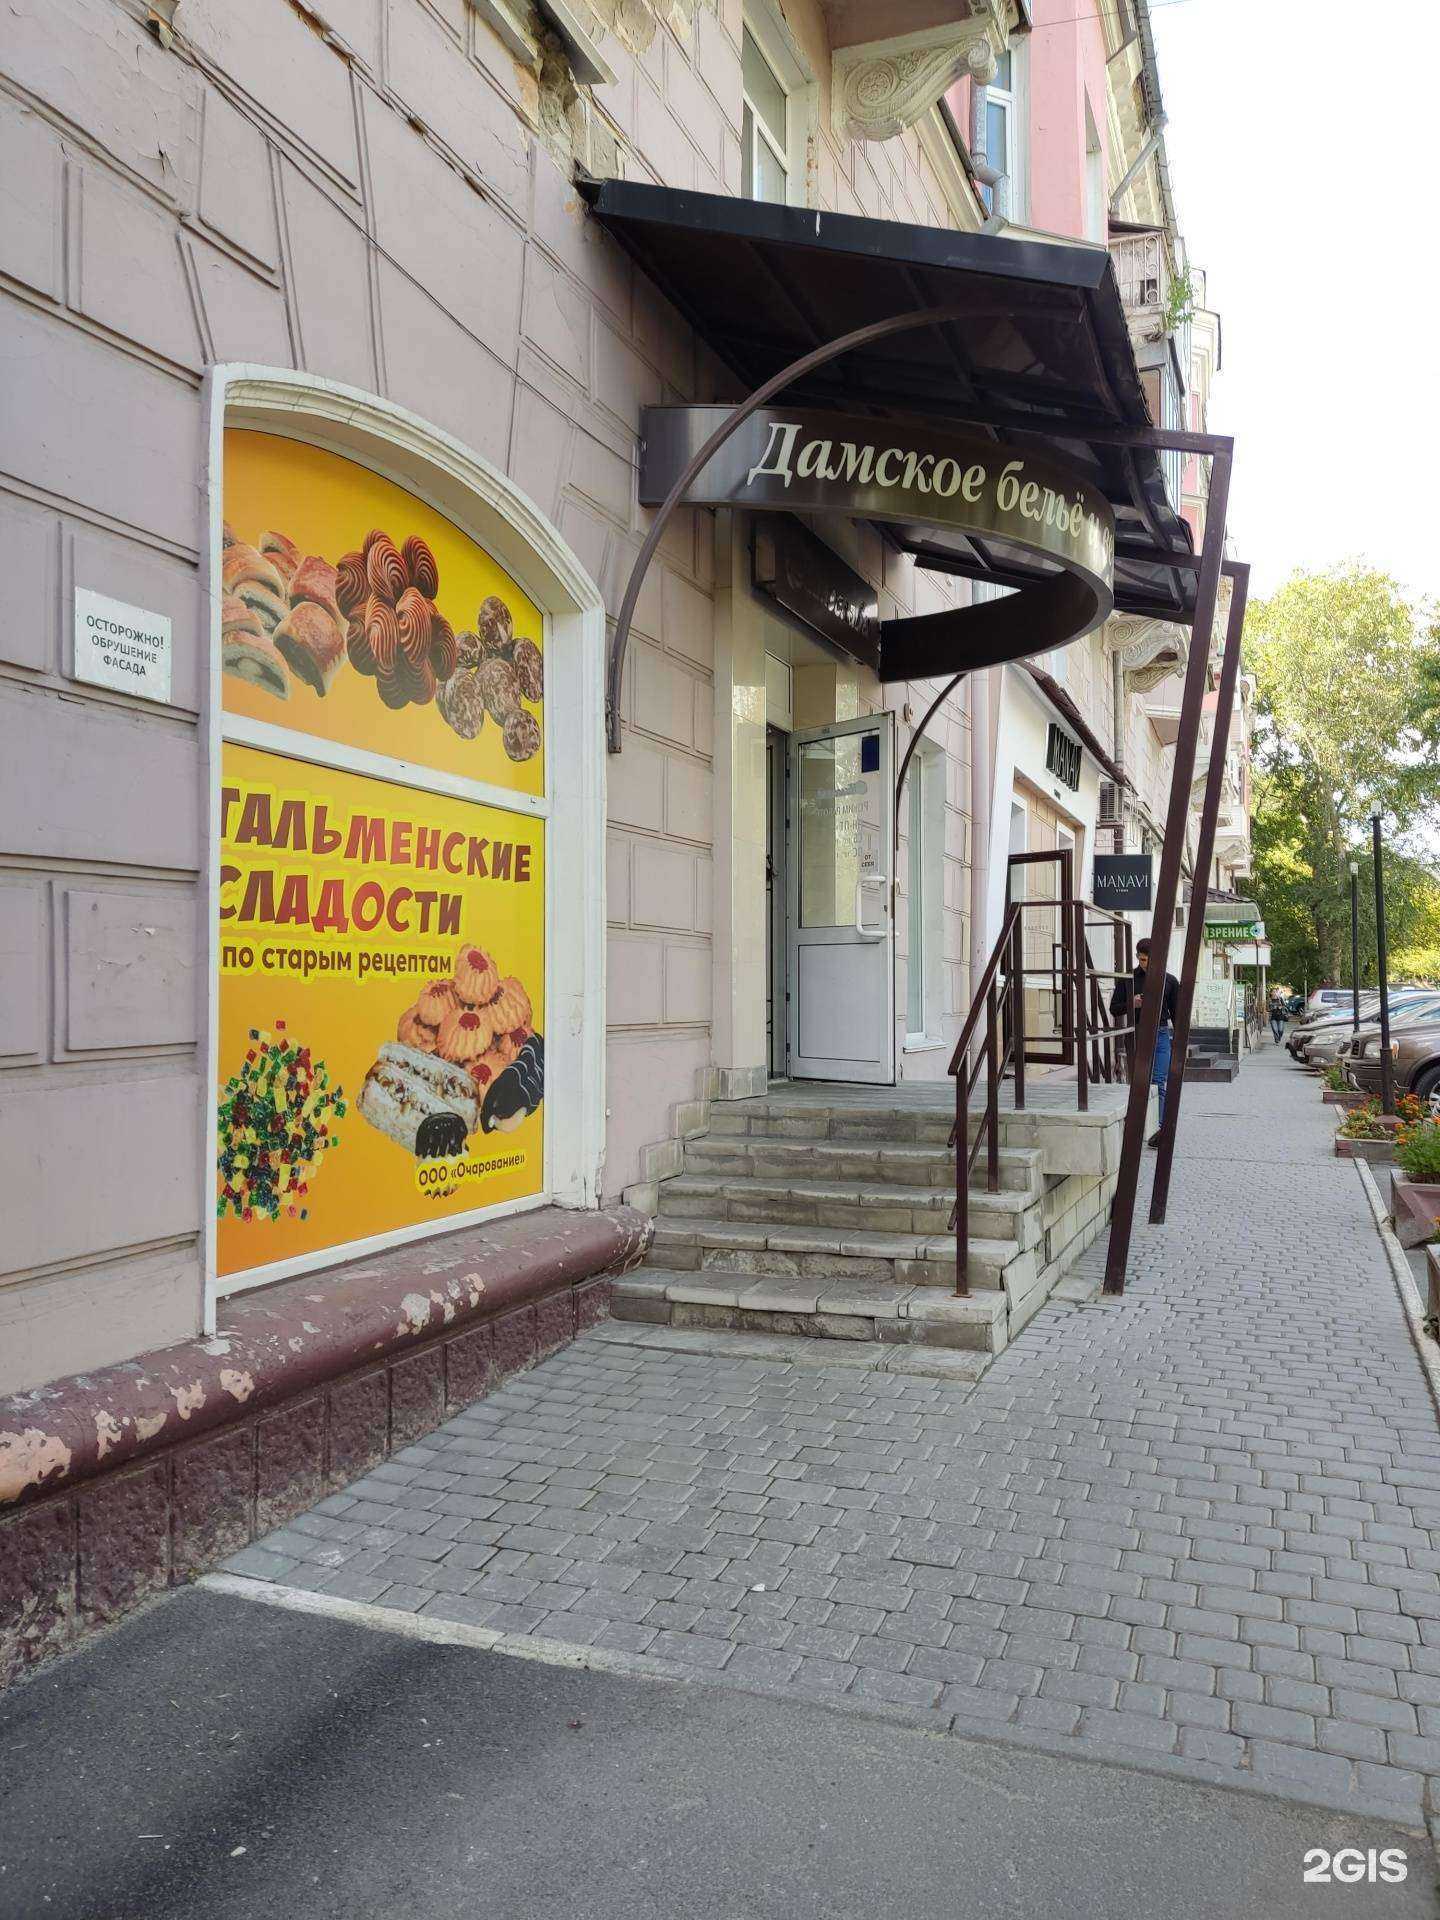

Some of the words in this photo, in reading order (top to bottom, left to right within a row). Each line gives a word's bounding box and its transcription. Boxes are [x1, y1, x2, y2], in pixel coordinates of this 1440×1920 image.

[747, 423, 987, 502] Дамское
[997, 461, 1084, 538] бельё
[86, 615, 164, 649] ОСТОРОЖНО!
[91, 635, 157, 664] ОБРУШЕНИЕ
[103, 655, 146, 676] ФАСАДА
[1097, 874, 1149, 888] MANAVI
[220, 864, 463, 935] СЛАДОСТИ
[1209, 926, 1249, 939] ЗРЕНИЕ
[222, 945, 254, 968] по
[261, 945, 352, 978] старым
[358, 951, 451, 977] рецептам
[418, 1165, 448, 1186] ООО
[450, 1153, 525, 1179] «Очарование»
